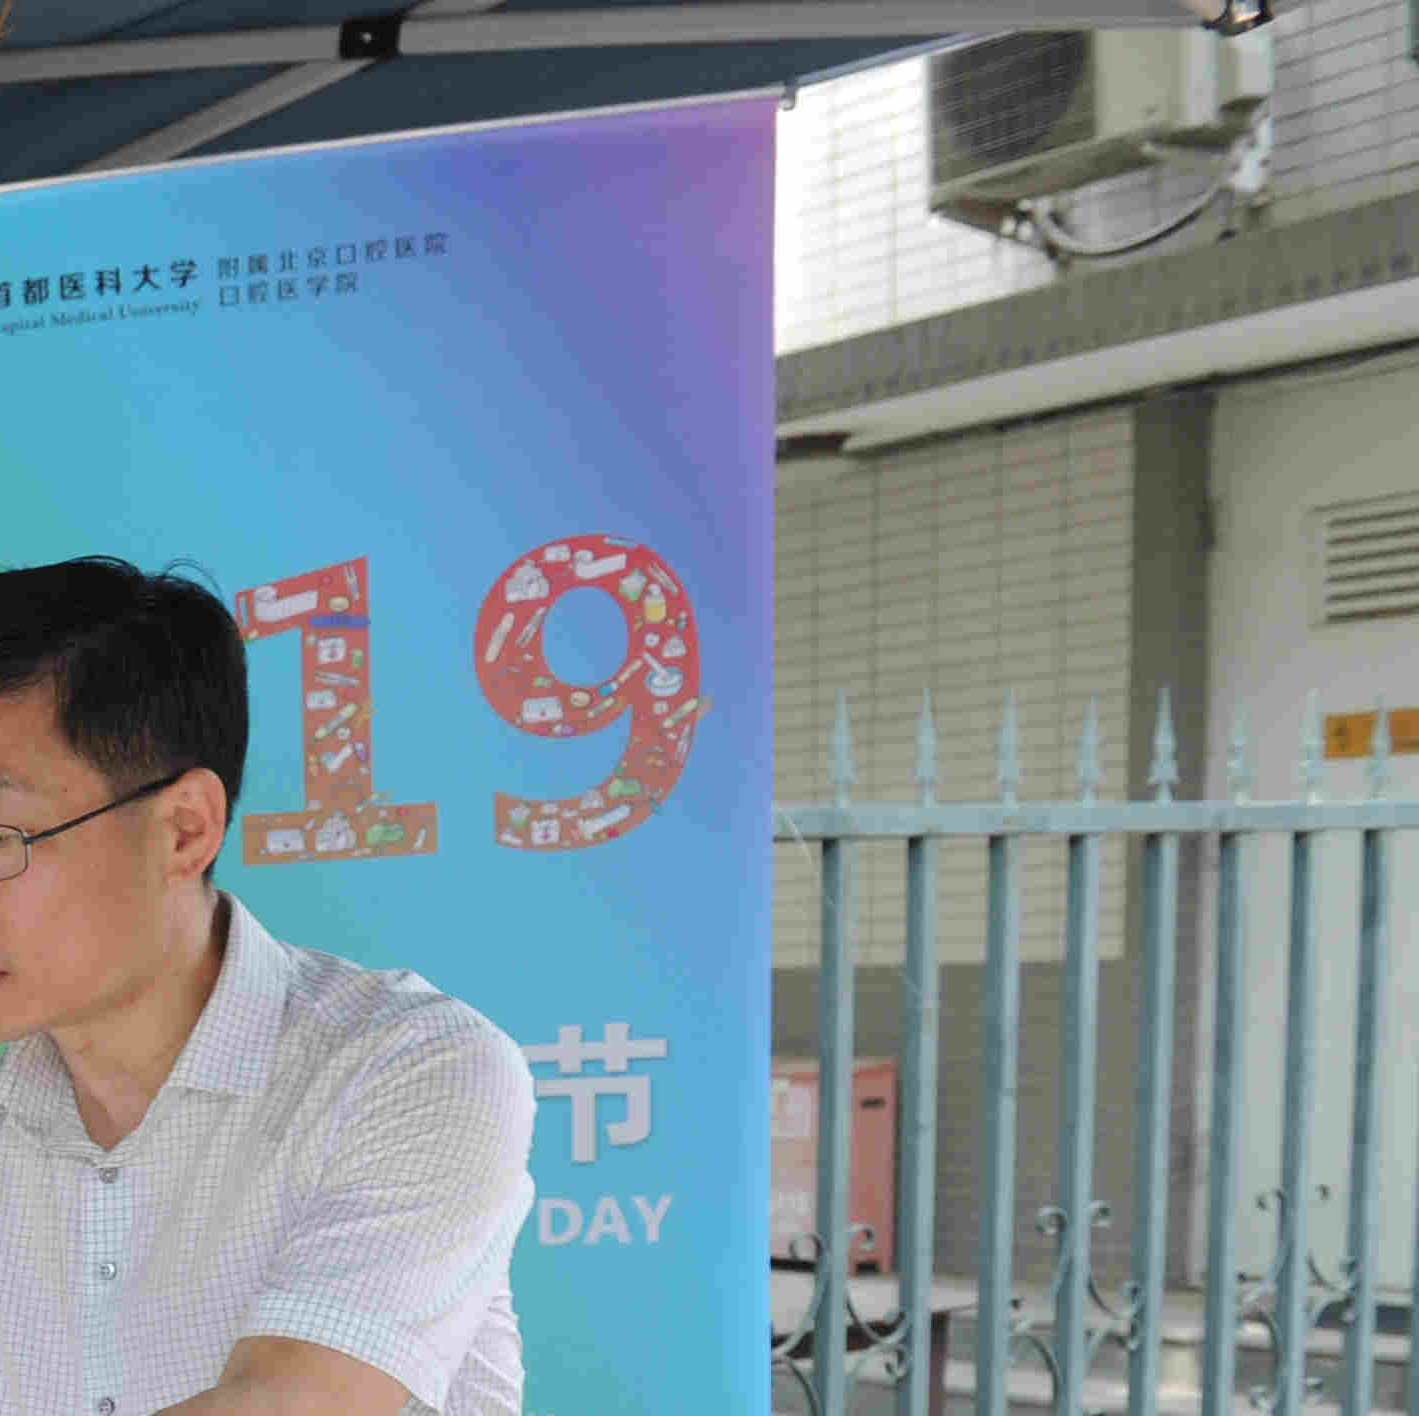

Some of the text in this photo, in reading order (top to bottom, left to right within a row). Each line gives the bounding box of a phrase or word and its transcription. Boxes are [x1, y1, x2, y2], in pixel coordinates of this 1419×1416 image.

[51, 307, 113, 328] Medical
[118, 298, 201, 320] University
[537, 1195, 673, 1247] DAY
